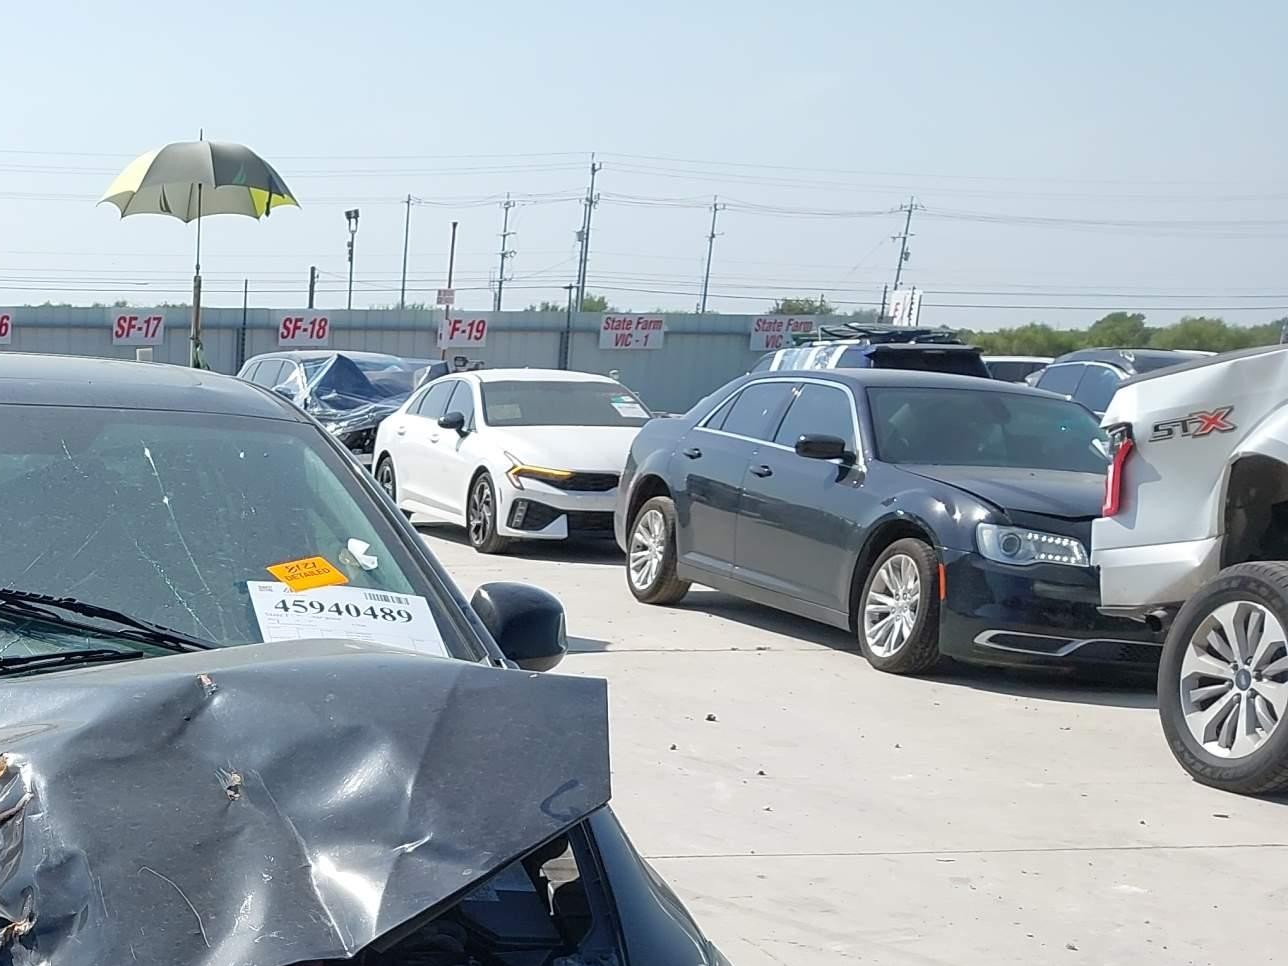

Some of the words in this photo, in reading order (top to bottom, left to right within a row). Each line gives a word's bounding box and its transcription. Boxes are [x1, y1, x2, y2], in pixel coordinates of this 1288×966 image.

[115, 315, 162, 338] SF-17
[280, 317, 328, 339] SF-18
[439, 319, 486, 340] F-19
[603, 316, 632, 331] State
[634, 316, 663, 331] Farm
[754, 318, 783, 332] State
[785, 318, 813, 331] Farm
[615, 333, 632, 347] VIC
[765, 334, 783, 349] VIC
[1148, 405, 1237, 443] STX
[284, 567, 330, 581] DETAILED
[274, 599, 413, 623] 45940489
